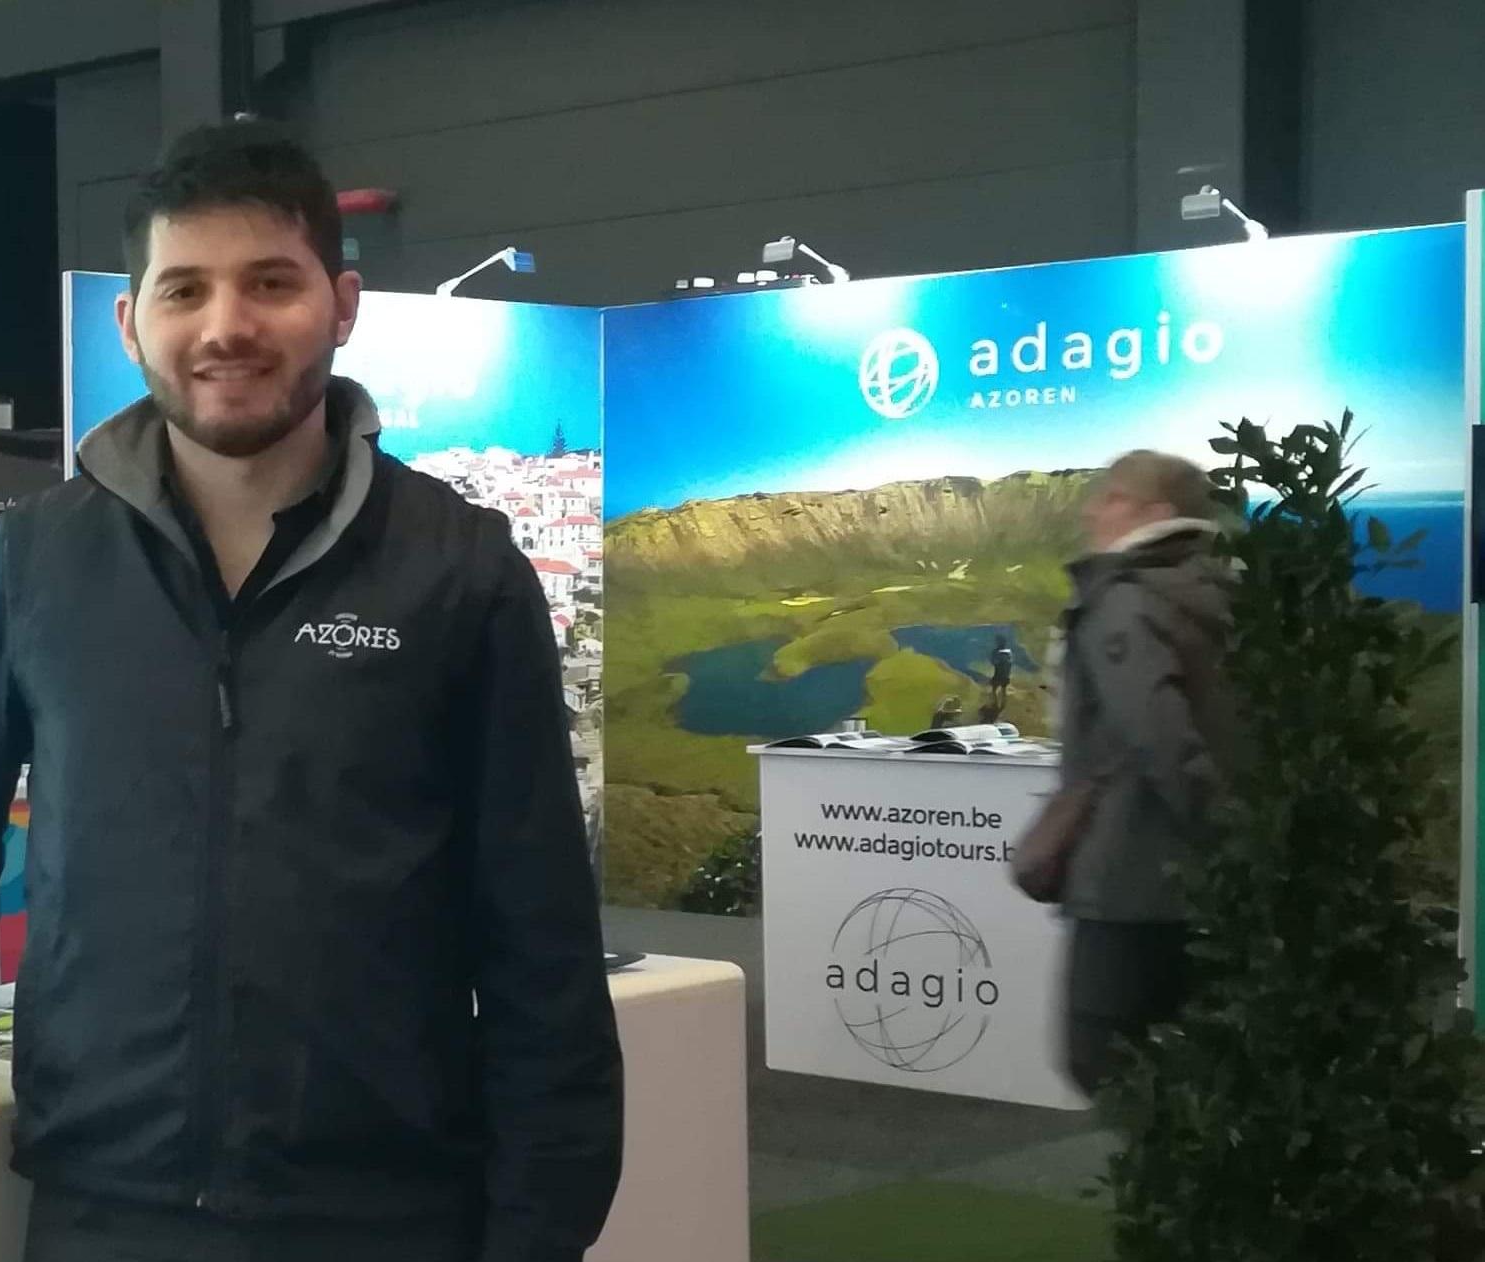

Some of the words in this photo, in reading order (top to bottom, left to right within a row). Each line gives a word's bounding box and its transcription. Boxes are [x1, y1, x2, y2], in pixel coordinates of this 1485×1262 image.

[969, 311, 1224, 380] adagio
[969, 386, 1077, 409] AZOREN
[294, 622, 401, 651] AZORES
[821, 803, 1003, 829] www.azoren.be
[794, 832, 1017, 863] www.adagiotours.b
[825, 959, 1000, 1008] adagio
